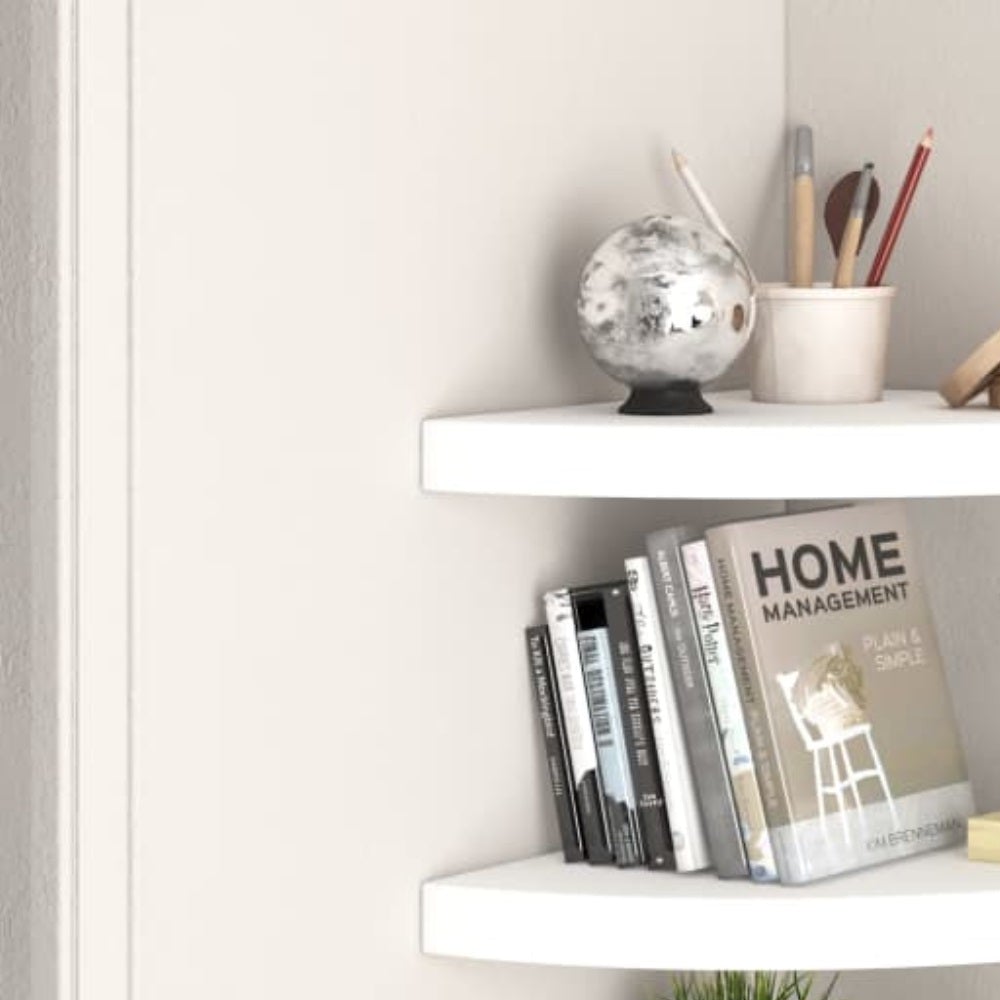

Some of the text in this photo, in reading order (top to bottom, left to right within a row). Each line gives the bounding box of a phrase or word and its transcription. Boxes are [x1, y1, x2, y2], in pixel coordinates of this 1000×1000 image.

[751, 532, 906, 597] HOME
[762, 581, 909, 623] MANAGEMENT
[725, 602, 755, 704] MANAGEMENT
[861, 627, 923, 651] PLAIN &
[873, 647, 926, 672] SIMPLE
